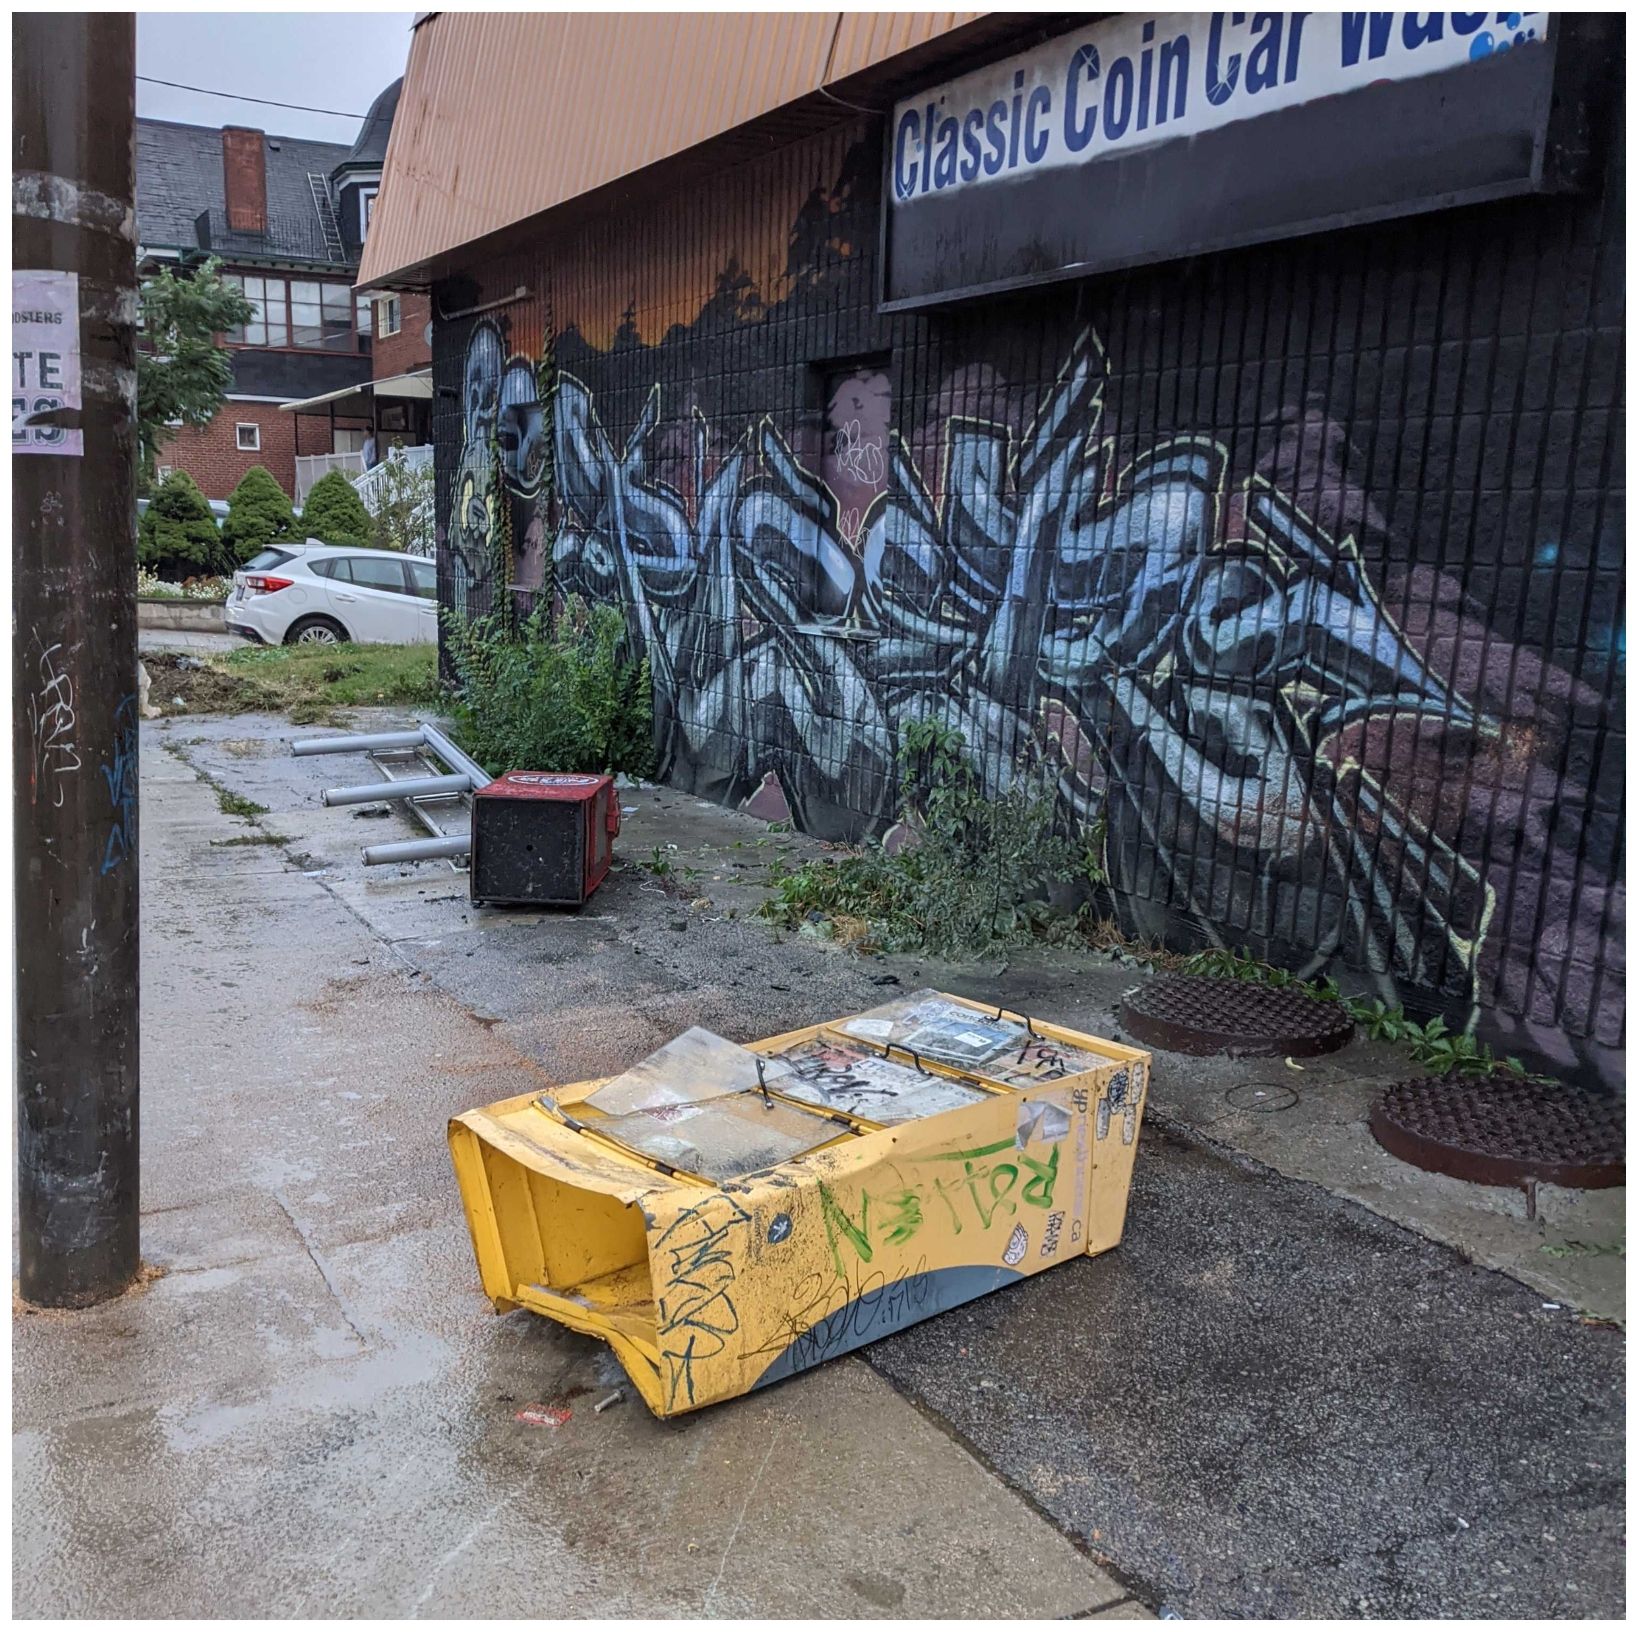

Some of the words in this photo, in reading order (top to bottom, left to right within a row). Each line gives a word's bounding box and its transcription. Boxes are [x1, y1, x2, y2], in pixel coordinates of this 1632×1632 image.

[895, 69, 1051, 200] Classic
[1064, 20, 1190, 152] Coin
[1205, 12, 1313, 106] Car
